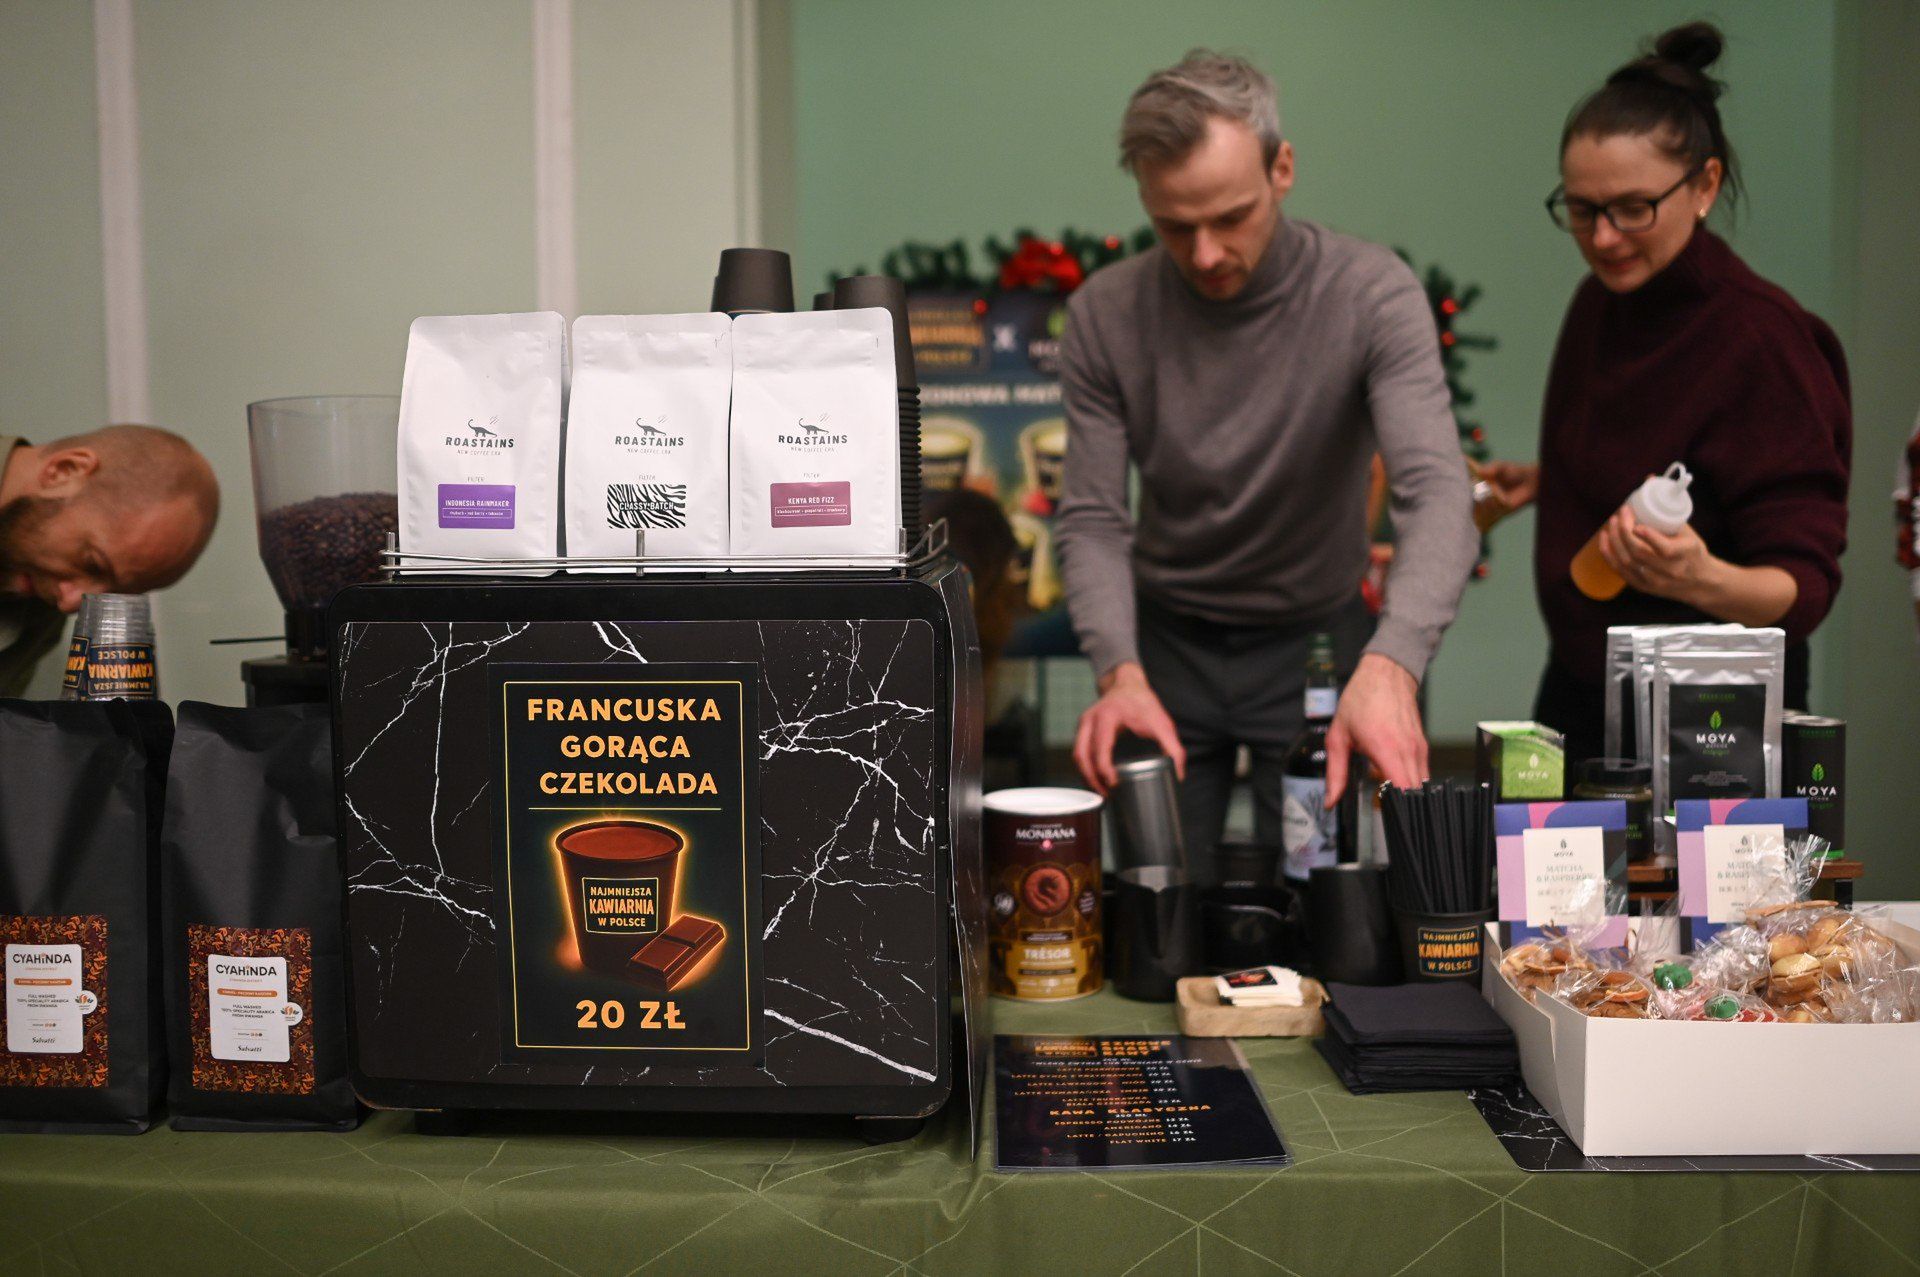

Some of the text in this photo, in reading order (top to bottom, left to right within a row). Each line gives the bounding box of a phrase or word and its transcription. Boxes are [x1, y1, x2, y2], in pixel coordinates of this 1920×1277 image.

[445, 436, 514, 448] ROASTAINS
[615, 436, 684, 447] ROASTAINS
[778, 434, 848, 445] ROASTAINS
[619, 502, 674, 511] CLASSY BATCH
[97, 650, 134, 660] POLSCE
[88, 663, 154, 679] KAWIARNIA
[528, 698, 722, 722] FRANCUSKA
[1695, 733, 1736, 744] MOYA
[560, 735, 691, 763] GORĄCA
[1518, 771, 1549, 779] MOYA
[539, 772, 718, 795] CZEKOLADA
[1796, 786, 1837, 796] MOYA
[1015, 828, 1077, 840] MONBANA
[590, 887, 652, 897] NAJMNIEJSZA
[589, 898, 655, 915] KAWIARNIA
[598, 917, 646, 927] W POLSCE
[1419, 941, 1480, 958] KAWIARNIA
[1438, 960, 1472, 971] POLSCE
[576, 1000, 686, 1029] 20 ZŁ
[1107, 1104, 1211, 1114] KLASYCZNA
